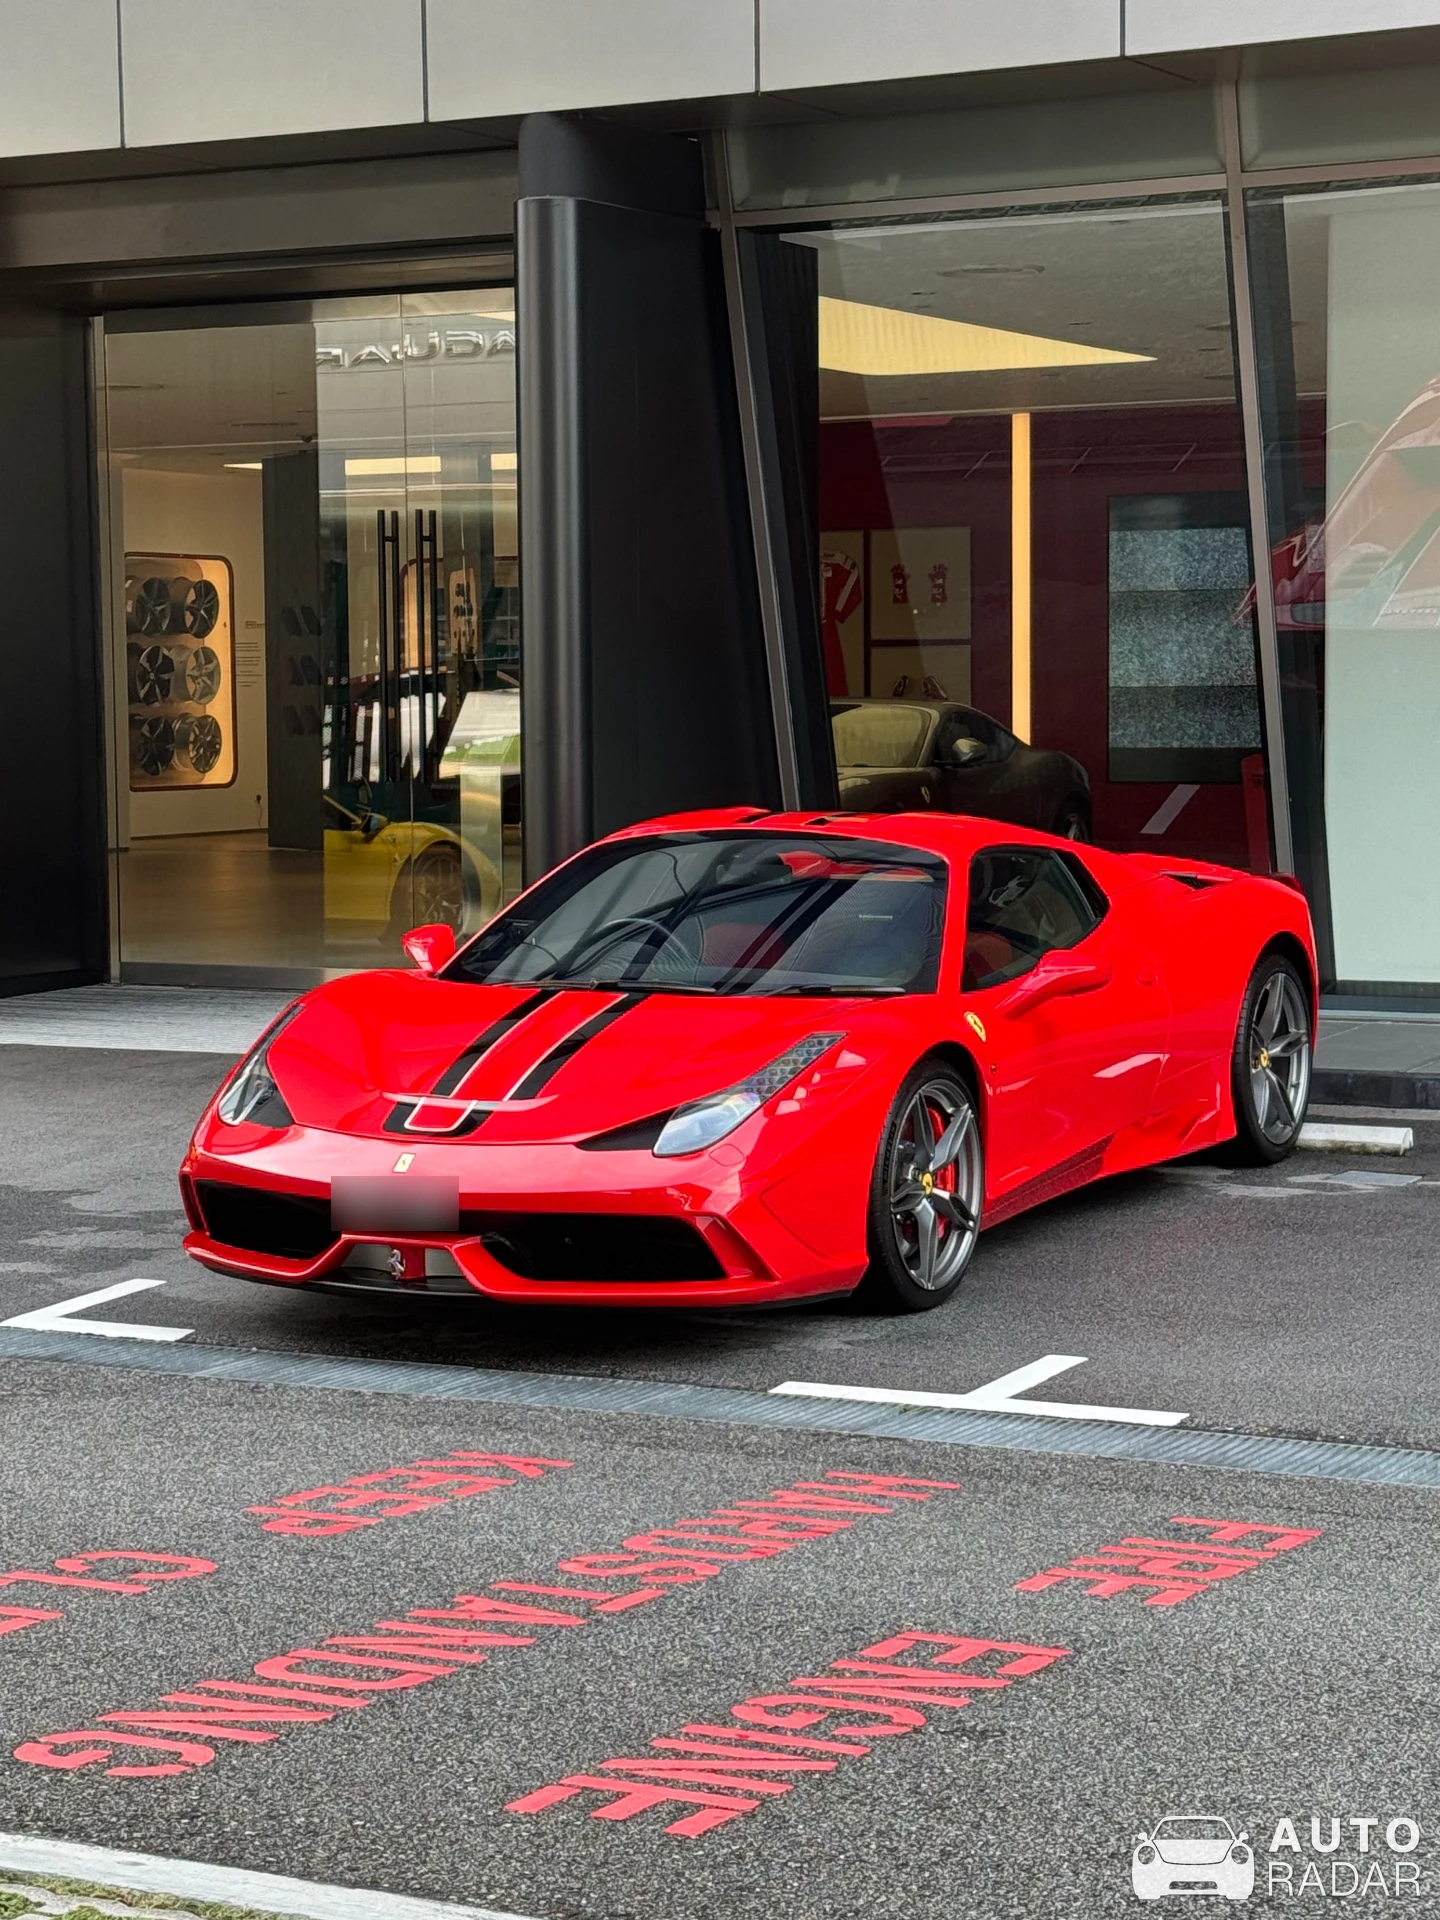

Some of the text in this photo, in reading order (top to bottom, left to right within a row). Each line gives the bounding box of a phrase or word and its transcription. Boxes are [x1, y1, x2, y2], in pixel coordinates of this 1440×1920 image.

[13, 1470, 961, 1778] HARDSTANDING
[247, 1450, 574, 1536] KEEP
[504, 1515, 1322, 1839] FIRE ENGINE
